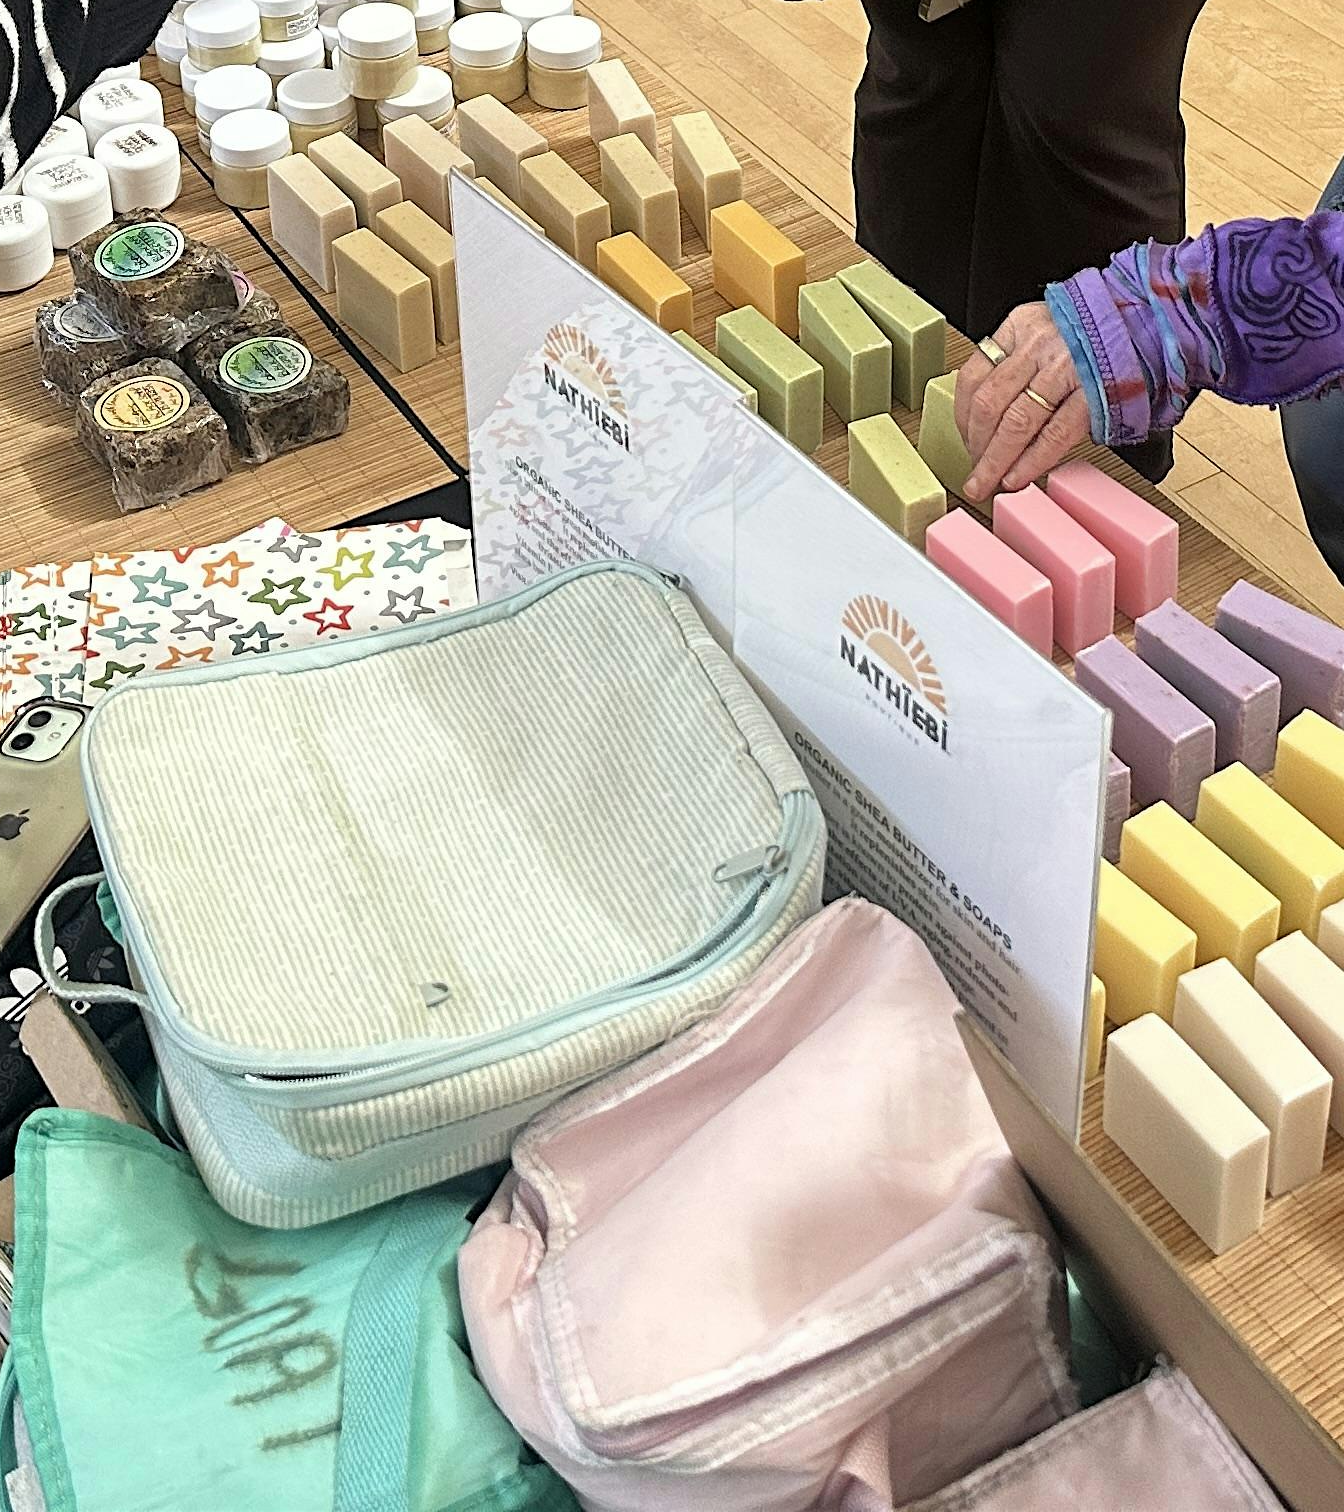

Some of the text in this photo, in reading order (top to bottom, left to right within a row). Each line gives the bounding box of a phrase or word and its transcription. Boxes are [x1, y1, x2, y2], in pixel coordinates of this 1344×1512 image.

[516, 456, 562, 503] ORGANIC
[564, 499, 593, 532] SHEA
[595, 525, 636, 562] BUTTE
[794, 732, 850, 792] ORGANIC
[854, 789, 889, 832] SHEA
[893, 824, 946, 887] BUTTER
[950, 879, 959, 901] &
[963, 892, 1012, 952] SOAPS
[859, 824, 915, 891] replenishes
[876, 826, 932, 891] moisturizer
[952, 899, 974, 931] skin
[976, 924, 995, 953] and
[898, 880, 932, 924] protect
[935, 917, 971, 963] against
[954, 952, 994, 1001] redness
[997, 994, 1016, 1024] and
